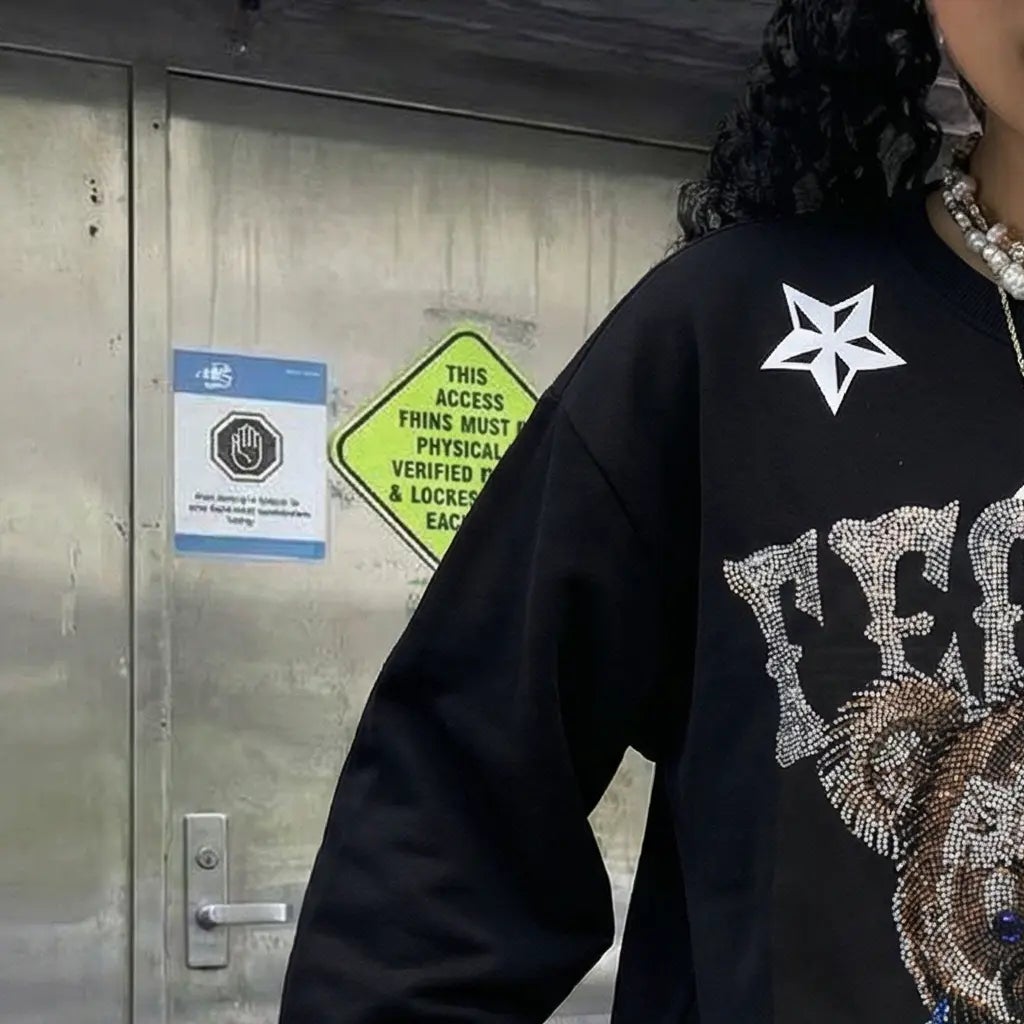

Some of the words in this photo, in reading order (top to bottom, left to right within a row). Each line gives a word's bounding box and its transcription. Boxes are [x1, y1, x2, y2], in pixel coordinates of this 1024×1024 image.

[445, 364, 488, 386] THIS
[435, 388, 505, 411] ACCESS
[398, 409, 454, 431] FHINS
[460, 415, 511, 437] MUST
[416, 437, 502, 461] PHYSICAL
[392, 460, 473, 483] VERIFIED
[388, 485, 403, 502] &
[426, 512, 465, 531] EAC
